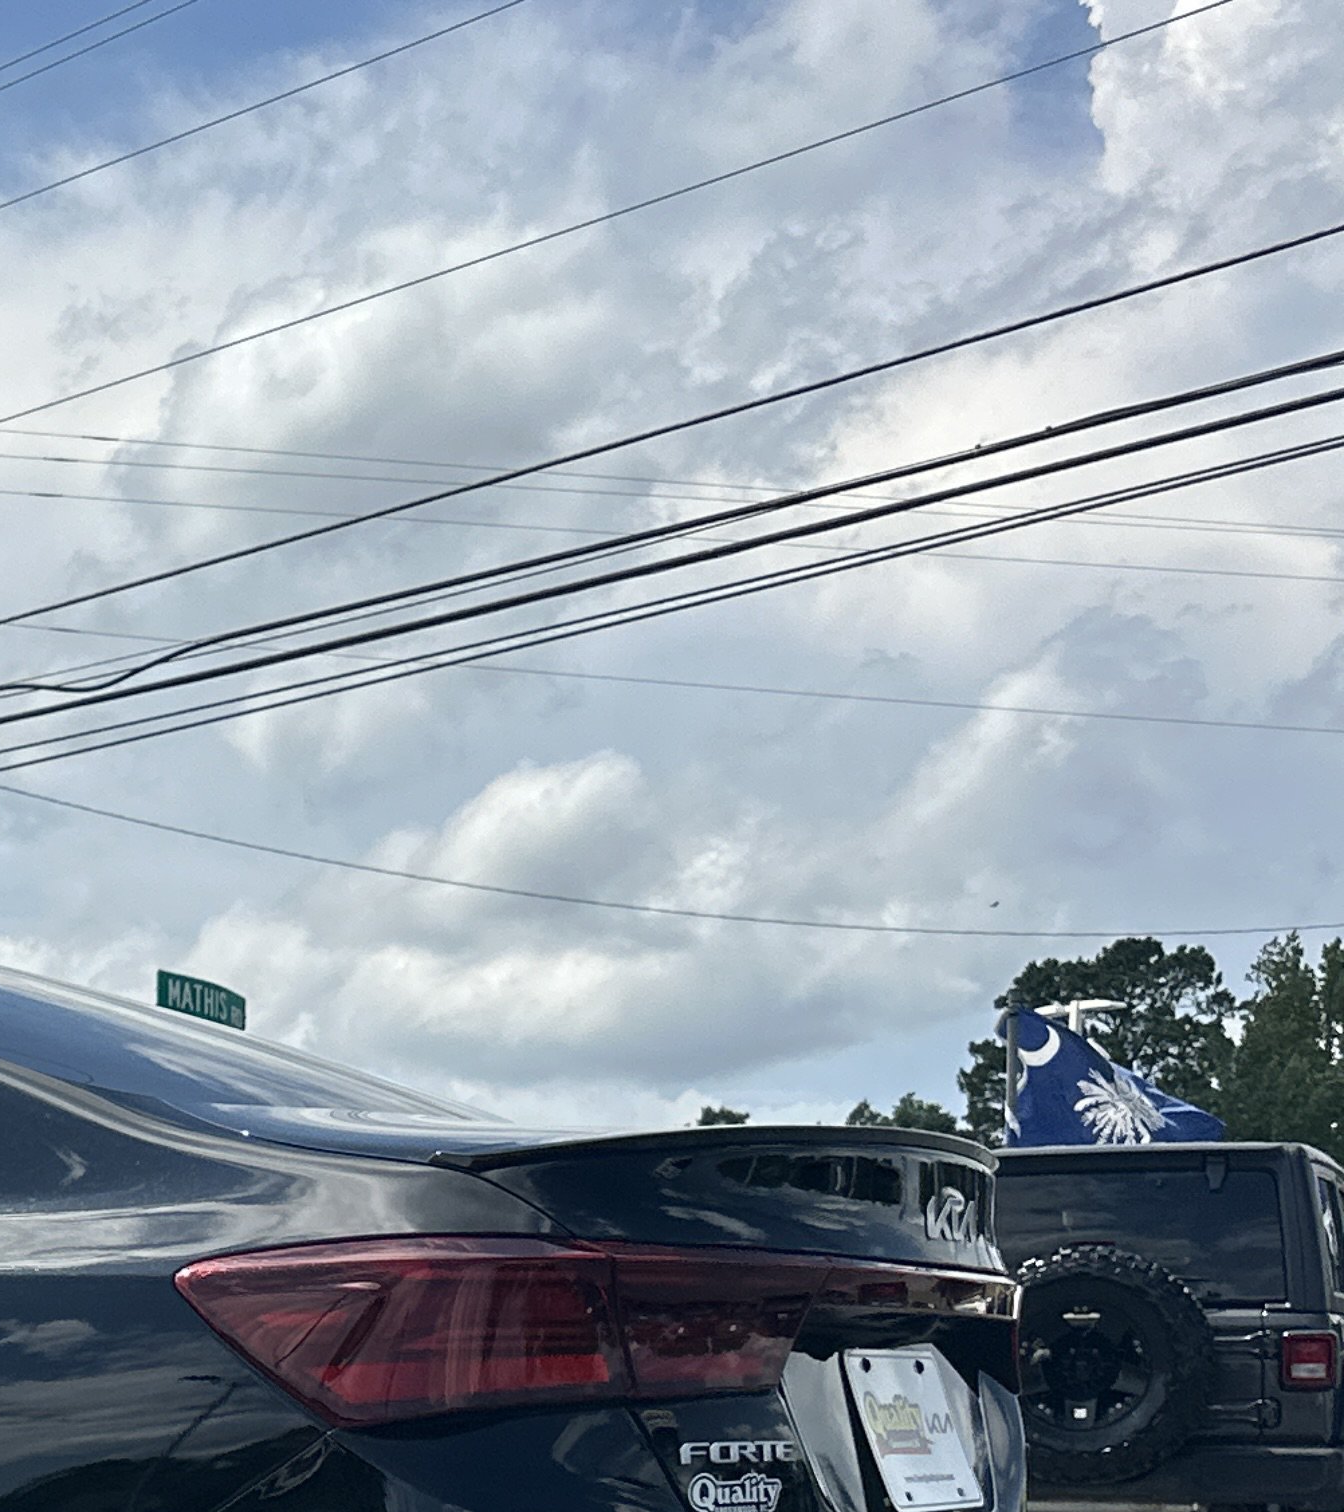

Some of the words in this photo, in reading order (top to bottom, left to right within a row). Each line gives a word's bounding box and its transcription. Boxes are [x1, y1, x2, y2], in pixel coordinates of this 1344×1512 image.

[168, 979, 228, 1020] MATHIS
[679, 1441, 794, 1465] FORTE
[692, 1475, 778, 1511] Quality
